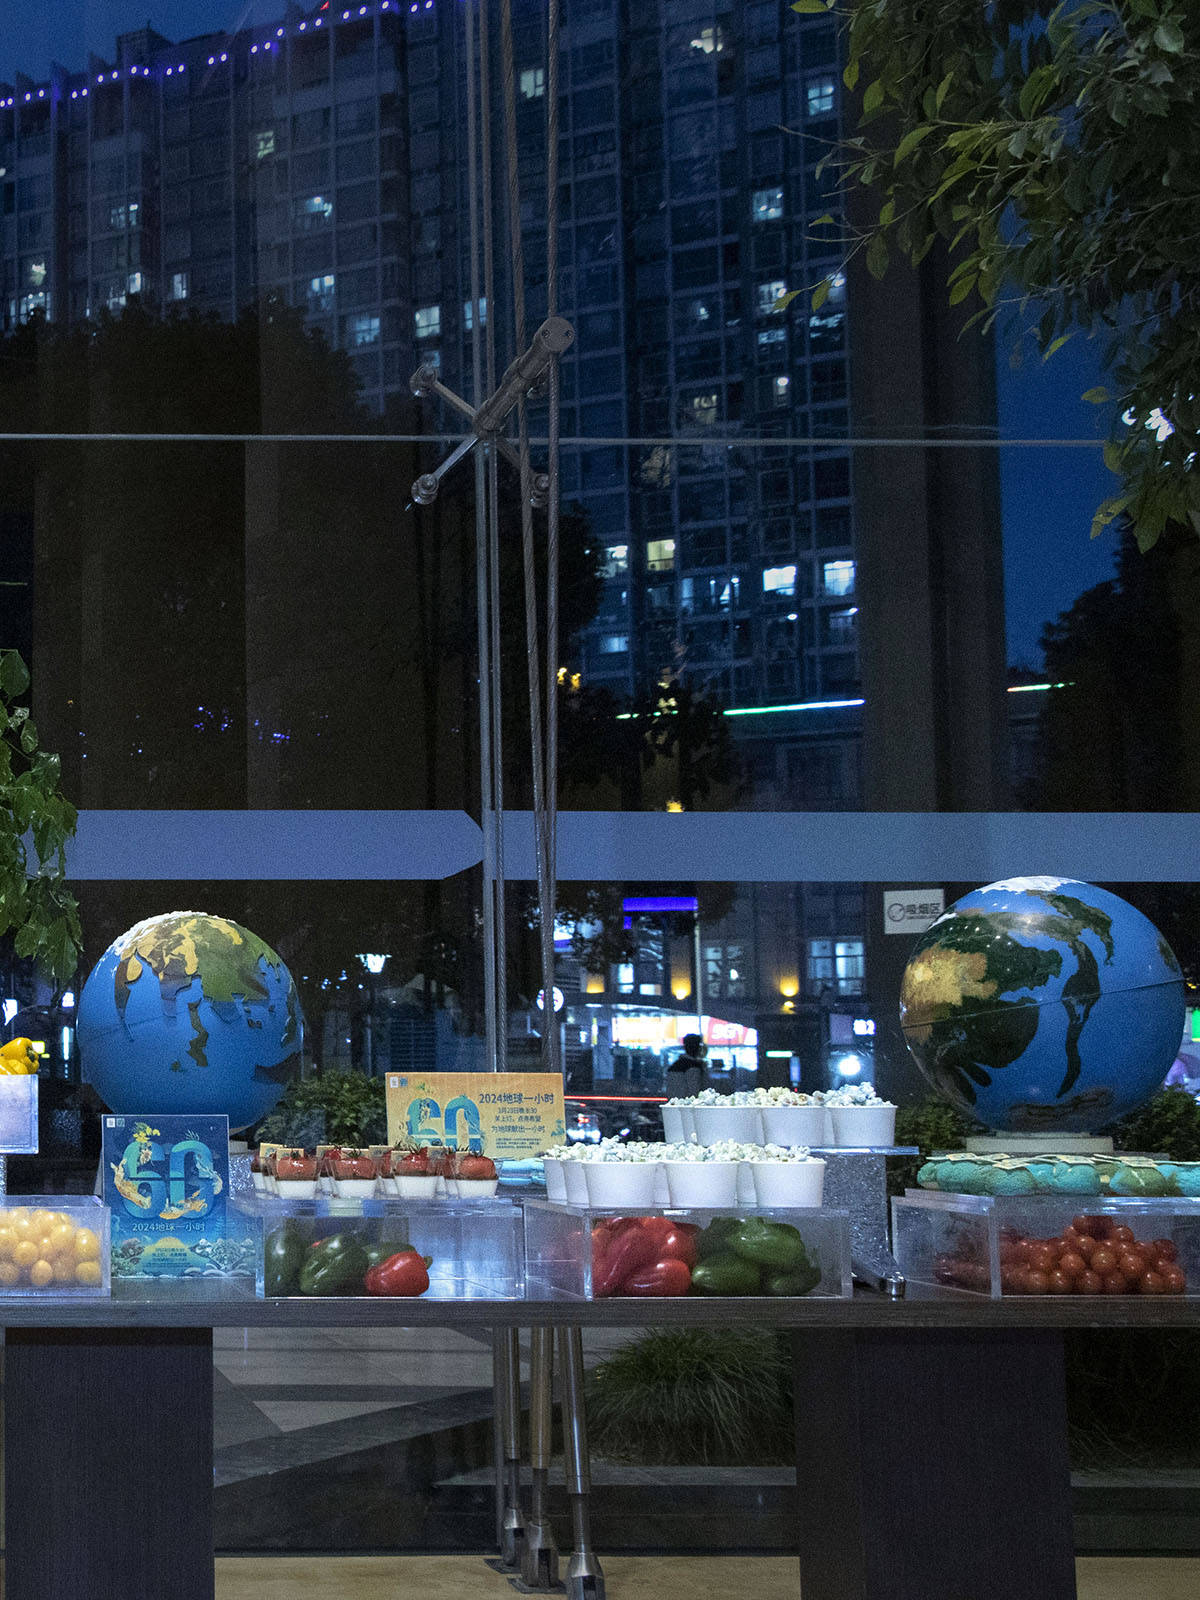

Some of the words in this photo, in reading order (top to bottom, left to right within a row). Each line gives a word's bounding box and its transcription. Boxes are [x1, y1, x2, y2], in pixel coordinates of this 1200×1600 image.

[478, 1092, 555, 1105] 2024地球一小时
[123, 1140, 215, 1219] 60
[132, 1222, 206, 1232] 2024地球一小时
